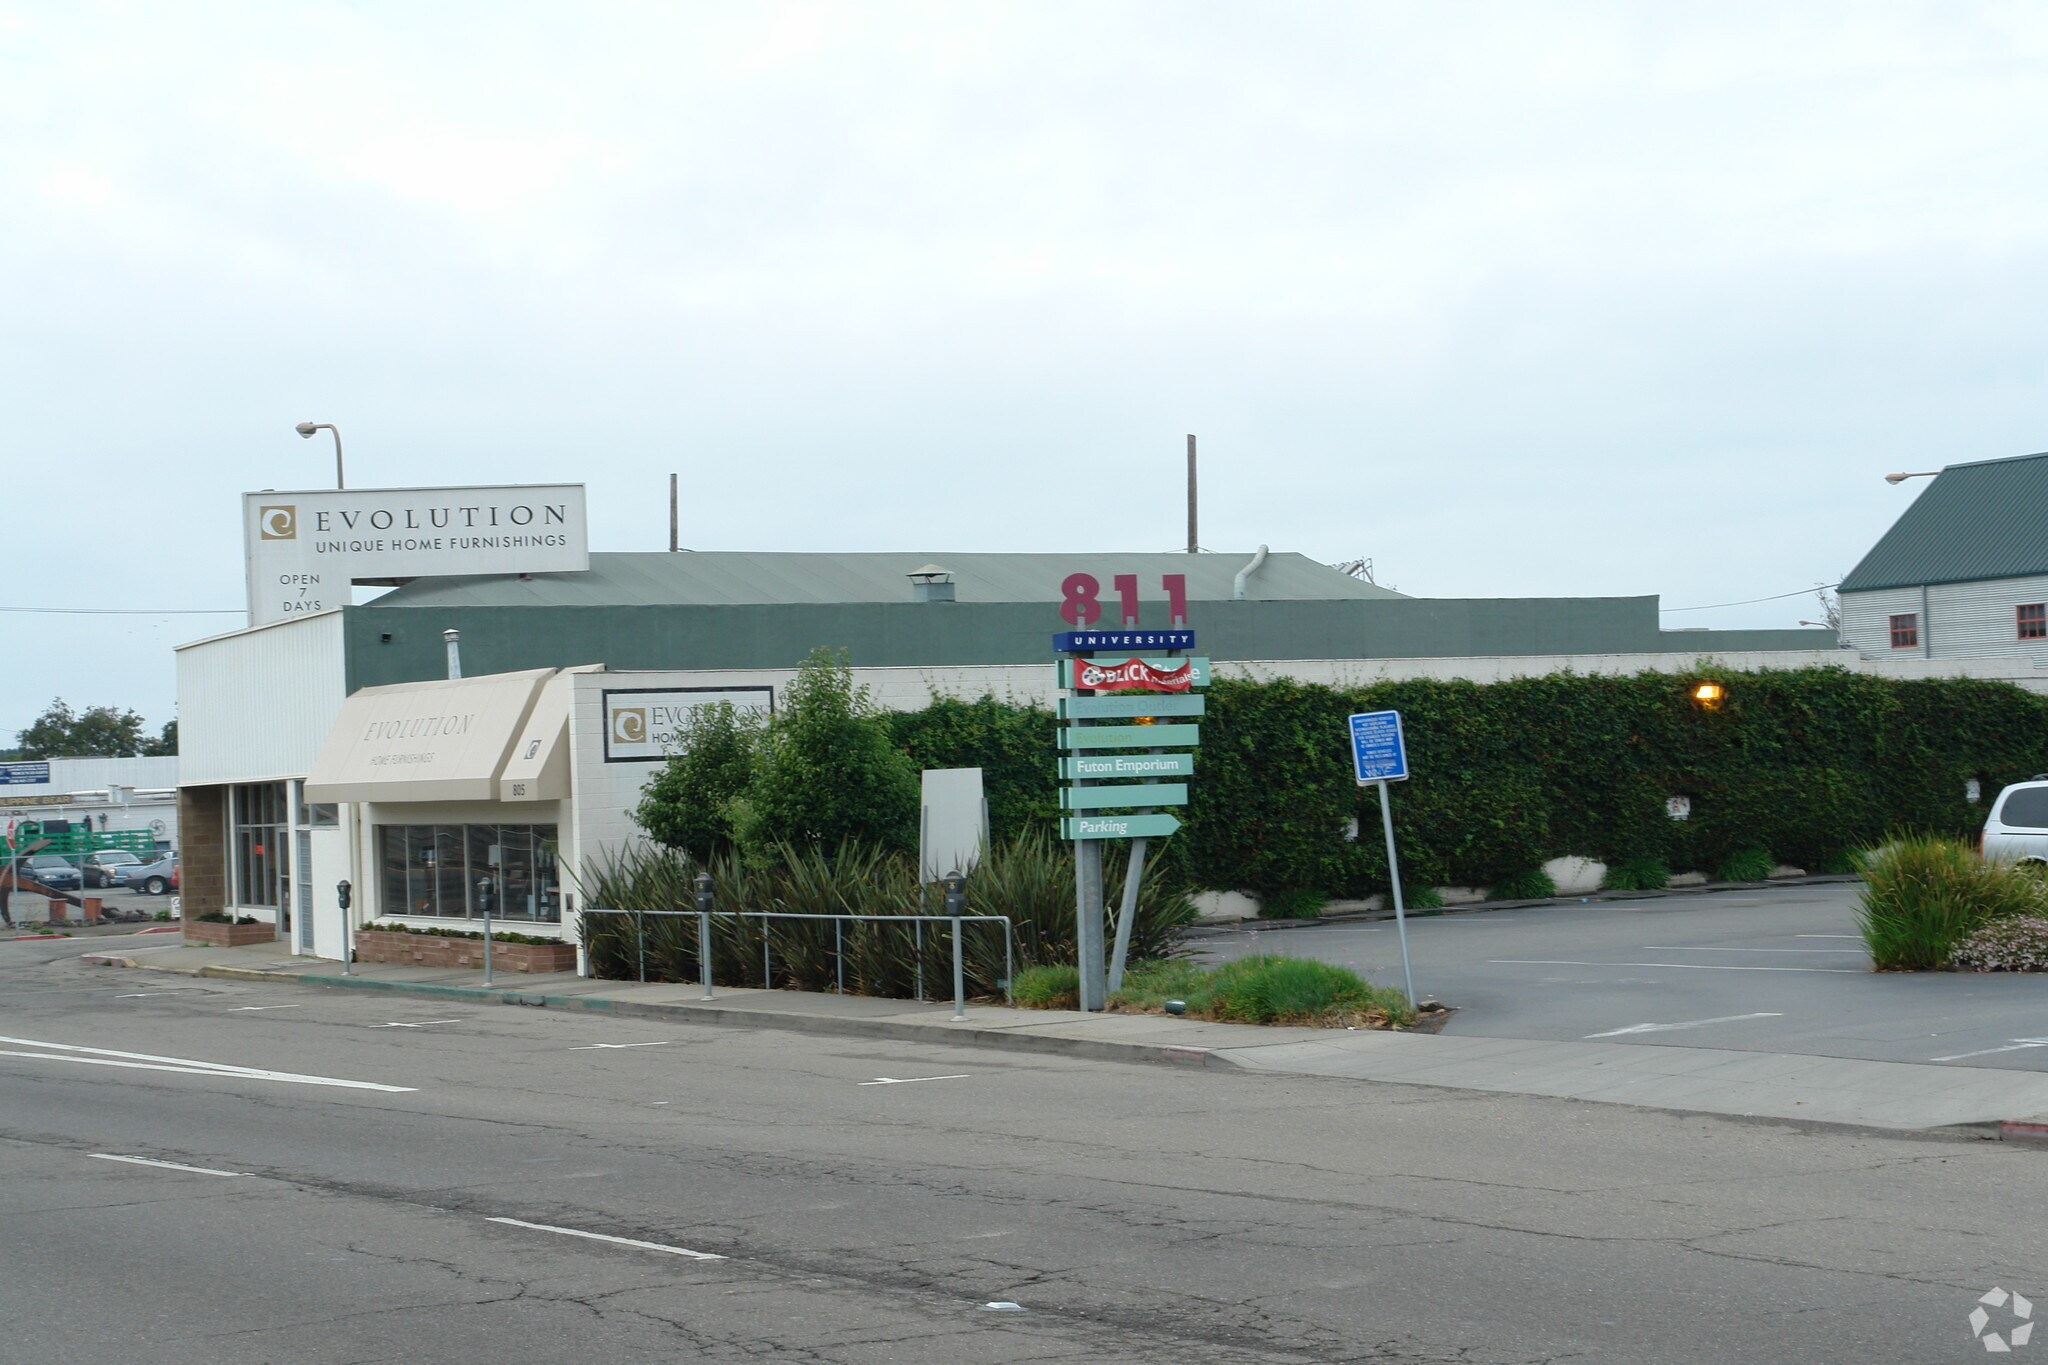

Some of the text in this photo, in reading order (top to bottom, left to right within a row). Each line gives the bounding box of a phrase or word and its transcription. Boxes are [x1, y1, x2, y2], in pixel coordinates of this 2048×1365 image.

[315, 504, 567, 532] EVOLUTION
[315, 534, 567, 554] UNIQUE HOME FURNISHINGS
[279, 573, 321, 586] OPEN
[299, 587, 307, 598] 7
[1059, 573, 1188, 625] 811
[283, 600, 322, 612] DAYS
[1074, 635, 1189, 645] UNIVERSITY
[363, 714, 475, 741] EVOLUTION
[652, 731, 685, 744] HOM
[1076, 759, 1179, 774] Futon Emporium
[512, 783, 525, 796] 805
[1079, 820, 1128, 835] Parking
